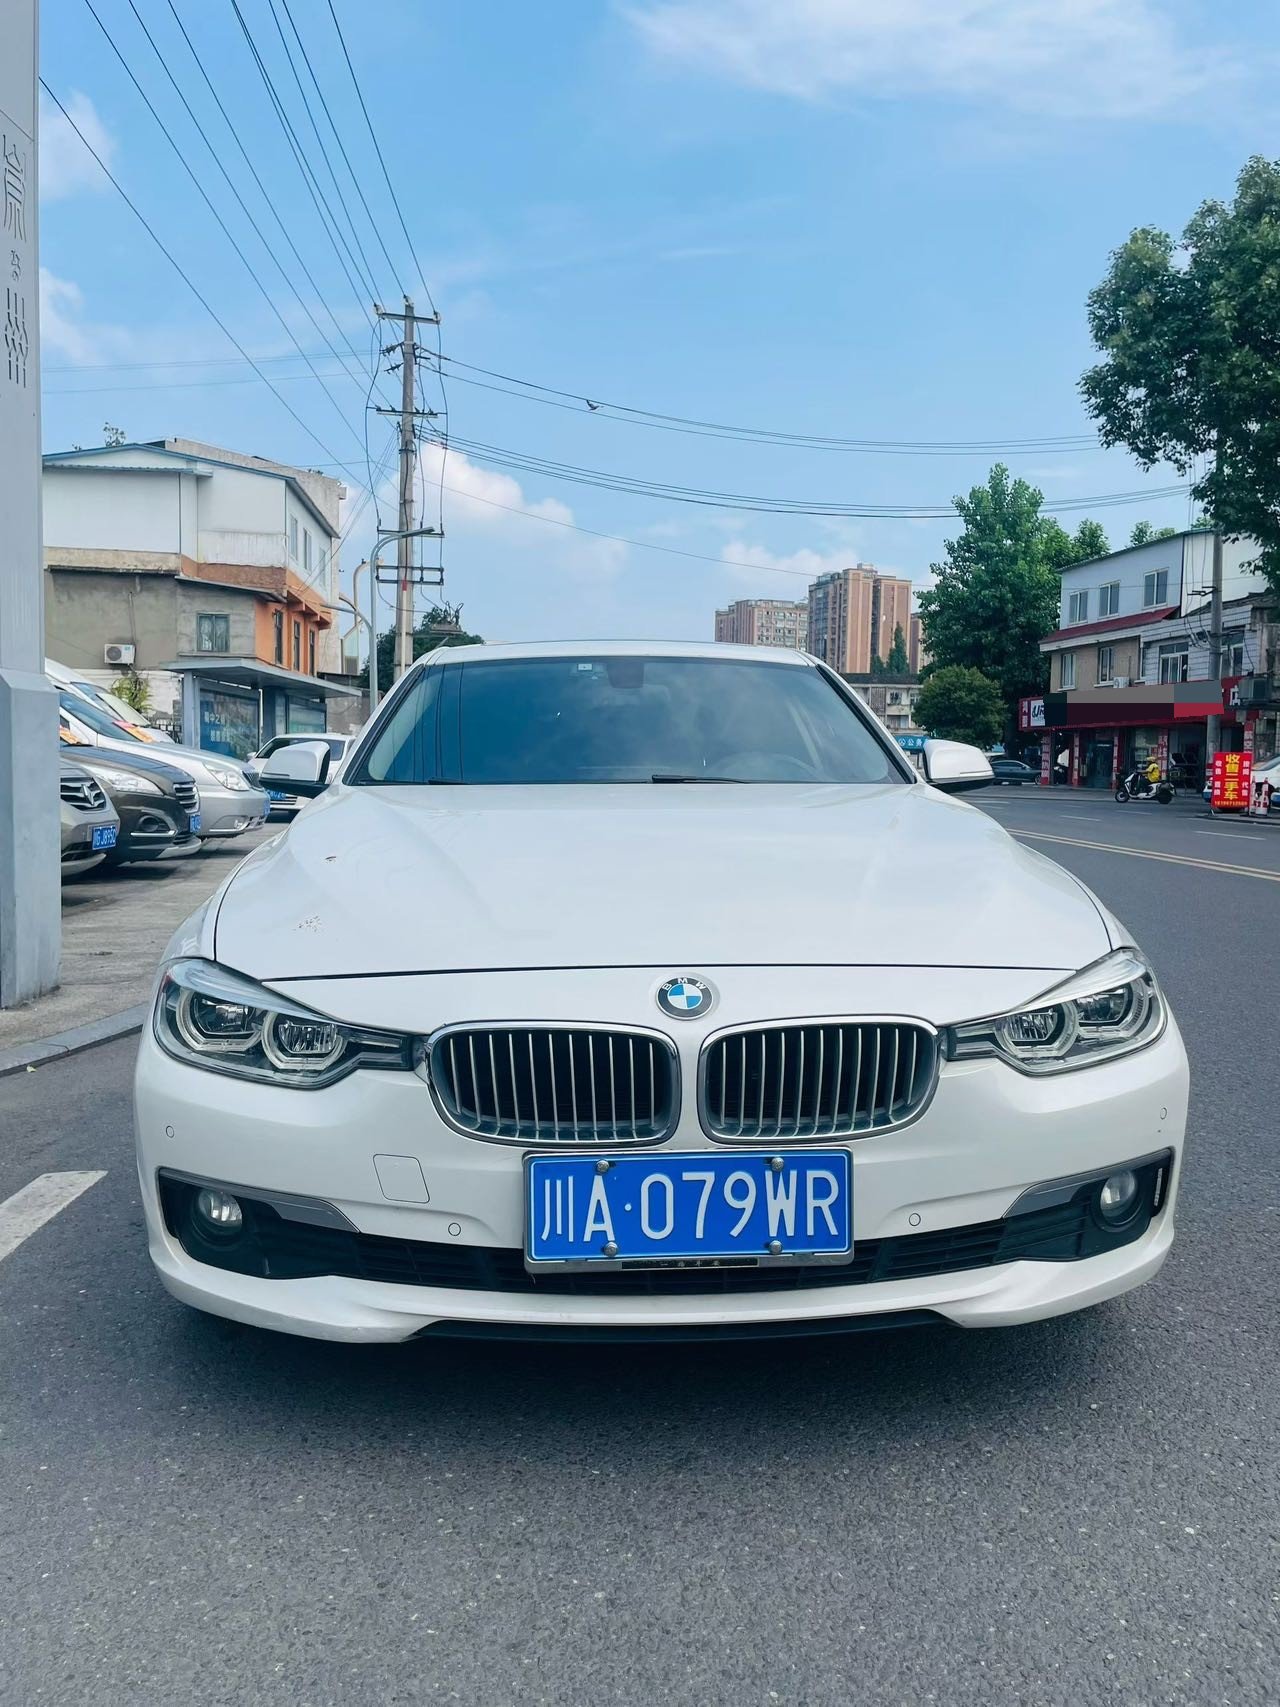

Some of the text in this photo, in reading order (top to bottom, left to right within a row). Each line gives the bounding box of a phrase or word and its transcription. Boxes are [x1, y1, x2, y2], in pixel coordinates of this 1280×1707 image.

[1224, 753, 1240, 800] 收售二手车
[662, 977, 706, 991] BMW
